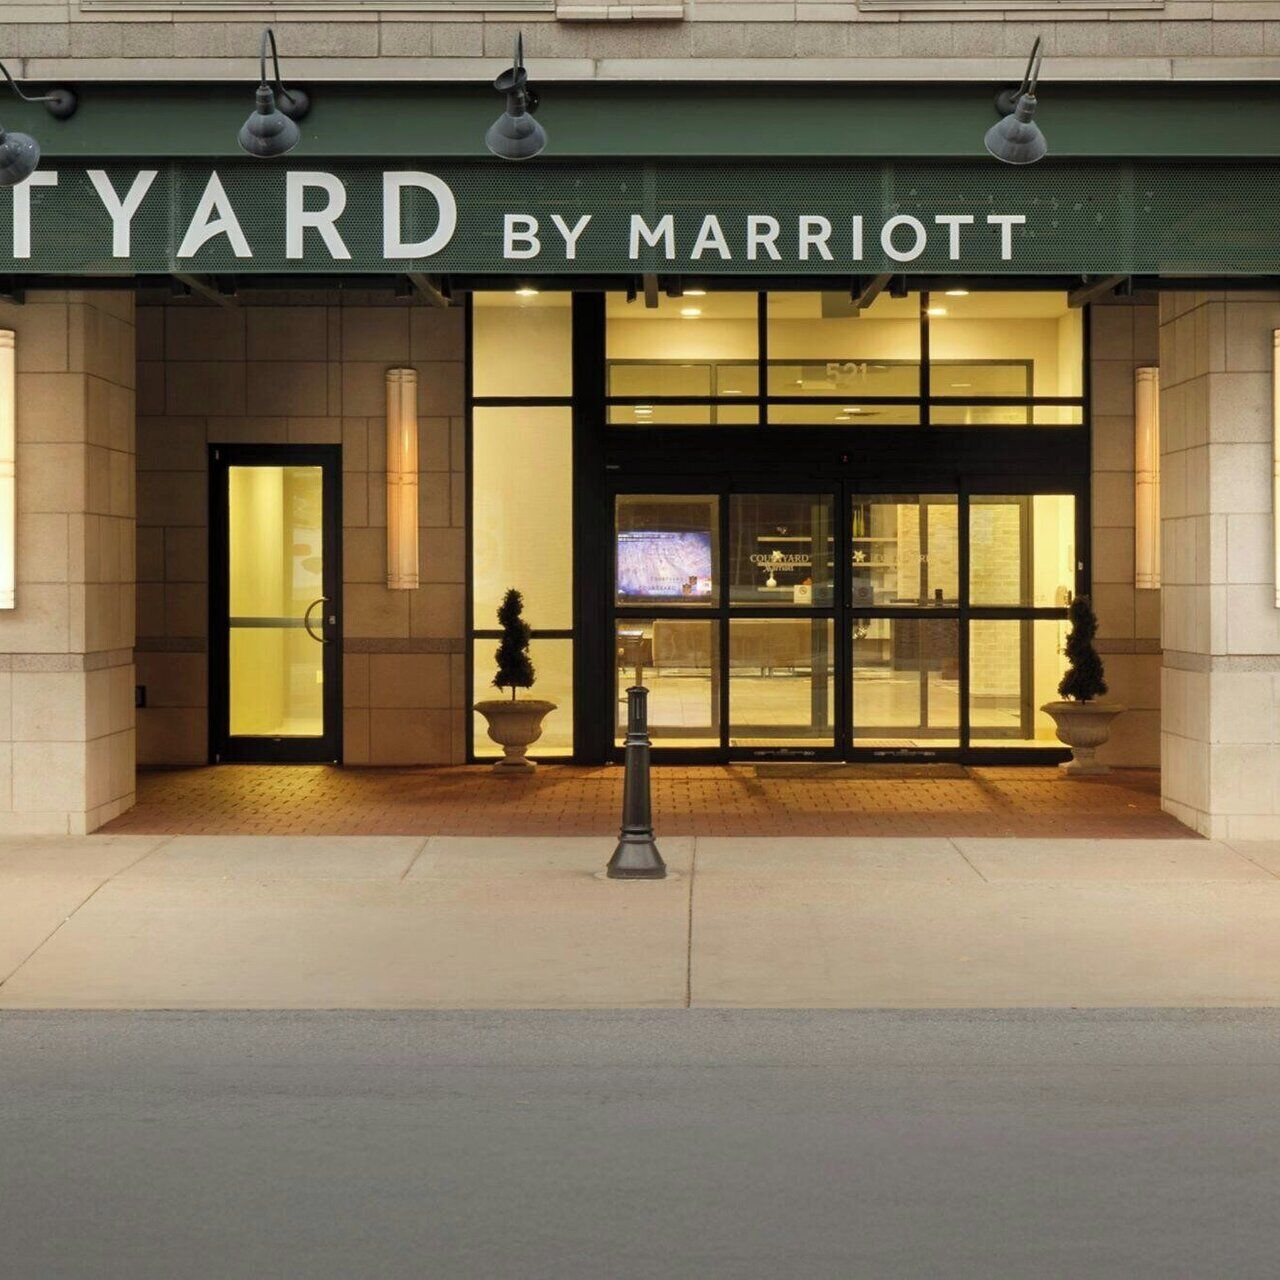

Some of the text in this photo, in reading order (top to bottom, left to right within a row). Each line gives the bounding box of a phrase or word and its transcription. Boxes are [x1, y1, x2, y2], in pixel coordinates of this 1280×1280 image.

[504, 214, 591, 259] BY
[629, 214, 1026, 261] MARRIOTT
[826, 362, 867, 385] 521
